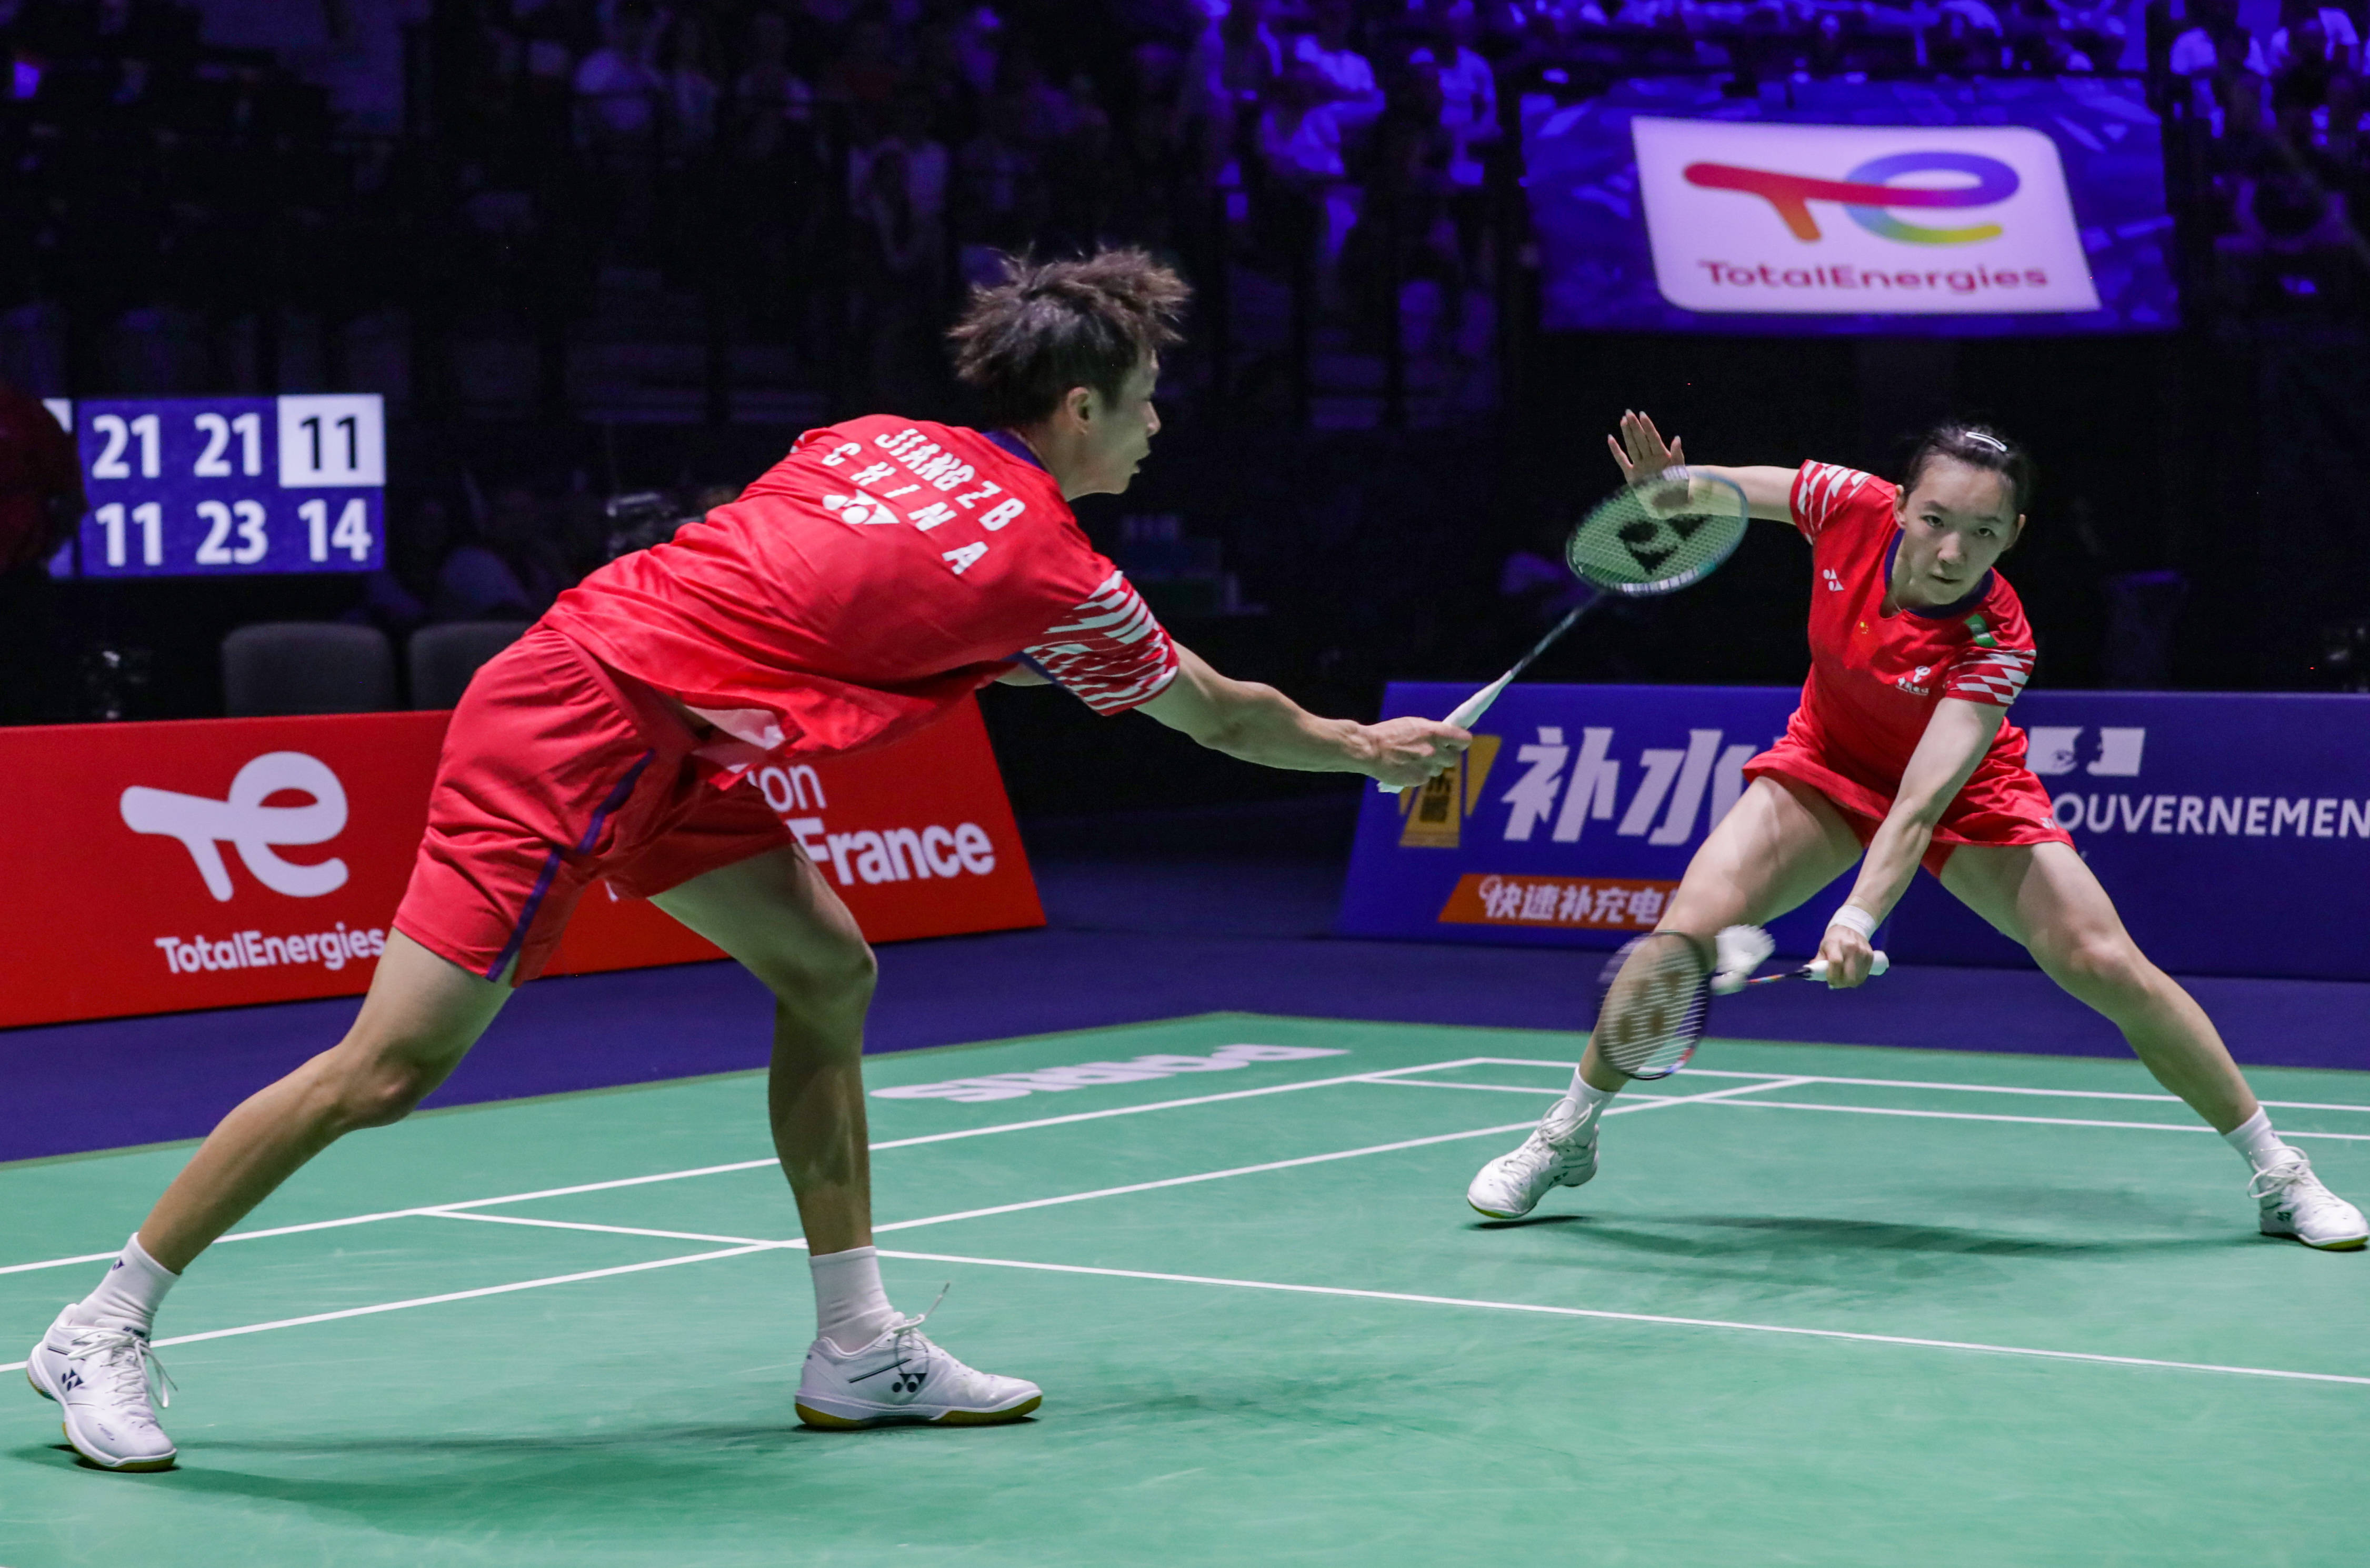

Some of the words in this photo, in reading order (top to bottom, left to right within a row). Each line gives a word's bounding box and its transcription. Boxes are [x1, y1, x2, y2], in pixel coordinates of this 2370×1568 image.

[1698, 260, 2048, 295] TotalEnergies
[92, 413, 160, 480] 21
[194, 412, 262, 477] 21
[300, 415, 357, 471] 11
[874, 428, 975, 492] JIANG
[95, 502, 162, 567] 11
[195, 499, 268, 565] 23
[298, 498, 372, 563] 14
[821, 442, 989, 575] CHINA
[1501, 726, 1786, 846] 补水
[785, 816, 996, 886] France
[1485, 882, 1679, 925] 快速补充电
[155, 921, 385, 973] TotalEnergies
[869, 1044, 1351, 1103] PARIS
